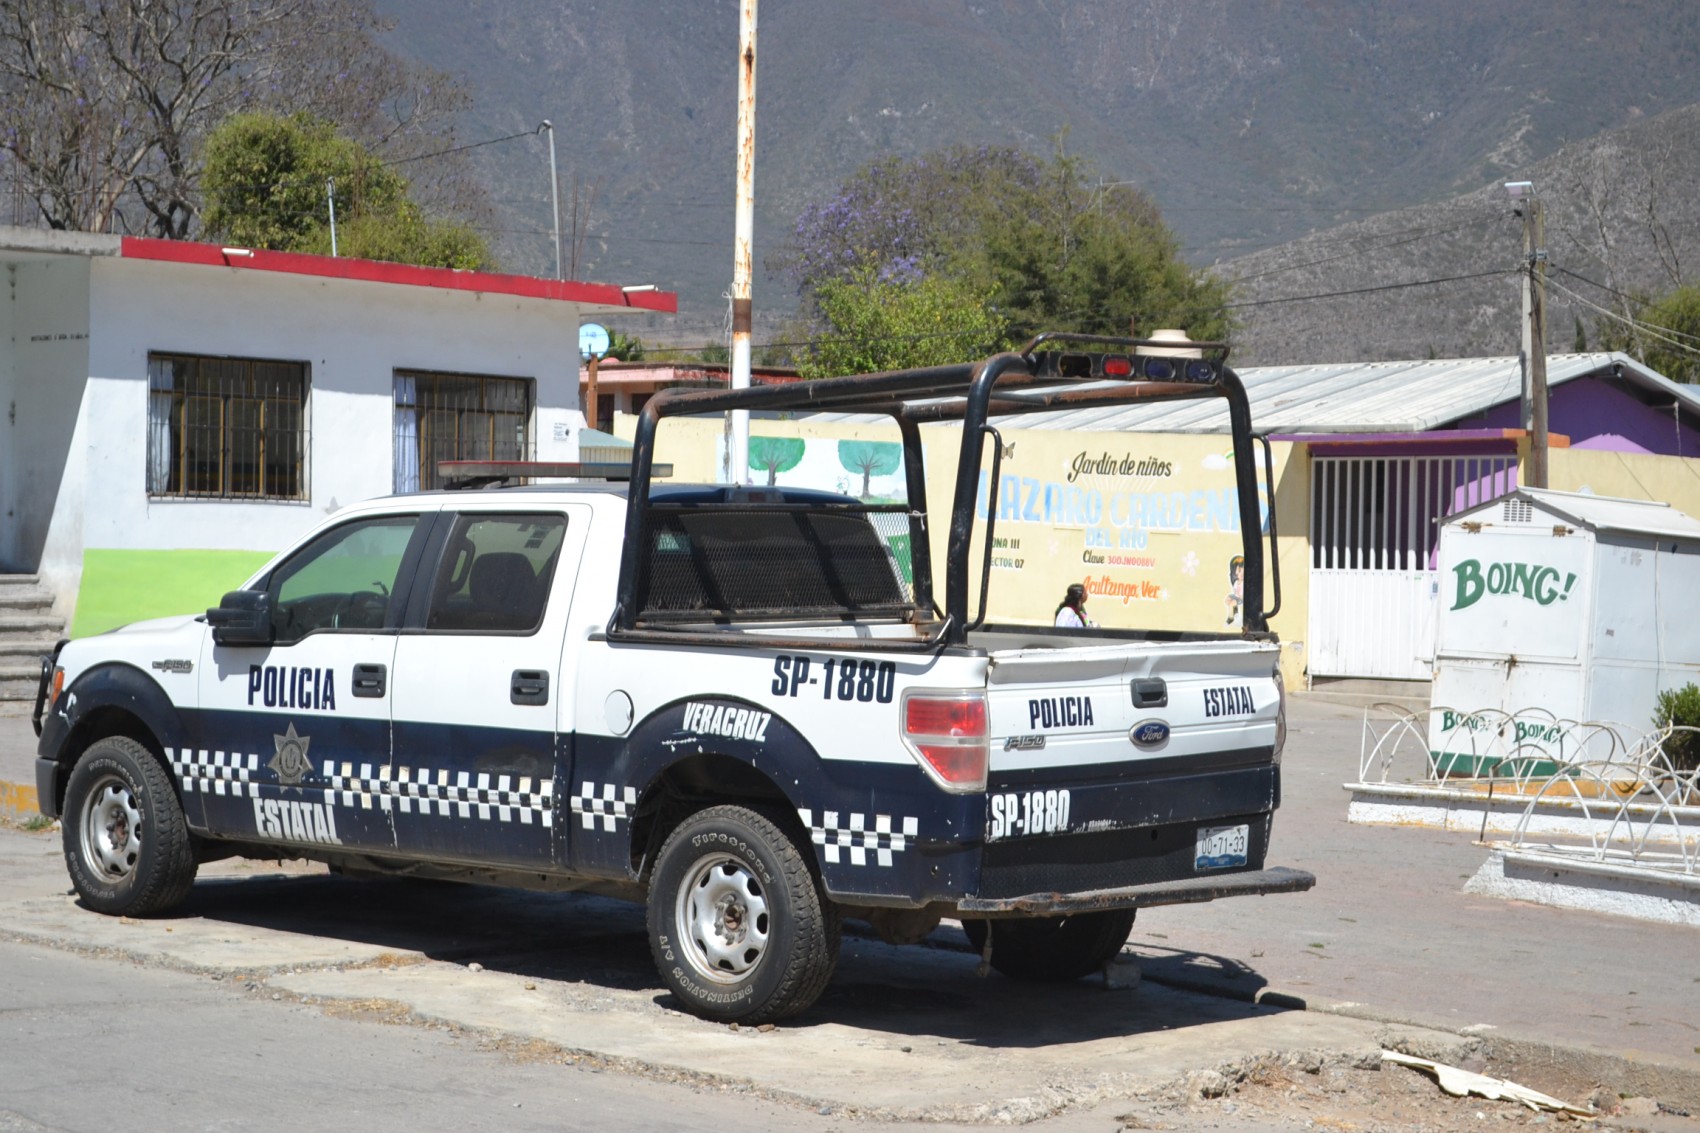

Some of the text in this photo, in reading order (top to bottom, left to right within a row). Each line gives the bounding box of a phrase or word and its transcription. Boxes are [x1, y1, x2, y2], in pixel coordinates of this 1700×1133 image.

[1067, 451, 1172, 483] Jardín de niños
[989, 537, 1008, 549] ONA
[1082, 550, 1105, 564] Clave
[1085, 527, 1113, 547] DEL
[989, 556, 1013, 568] ECTOR
[1450, 559, 1577, 611] BOING!
[248, 664, 336, 711] POLICIA
[771, 655, 896, 704] SP-1880
[682, 702, 772, 742] VERACRUZ
[1029, 686, 1256, 730] POLICIA ESTATAL
[1141, 725, 1165, 741] Ford
[253, 798, 343, 845] ESTATAL
[991, 790, 1070, 838] SP-1880
